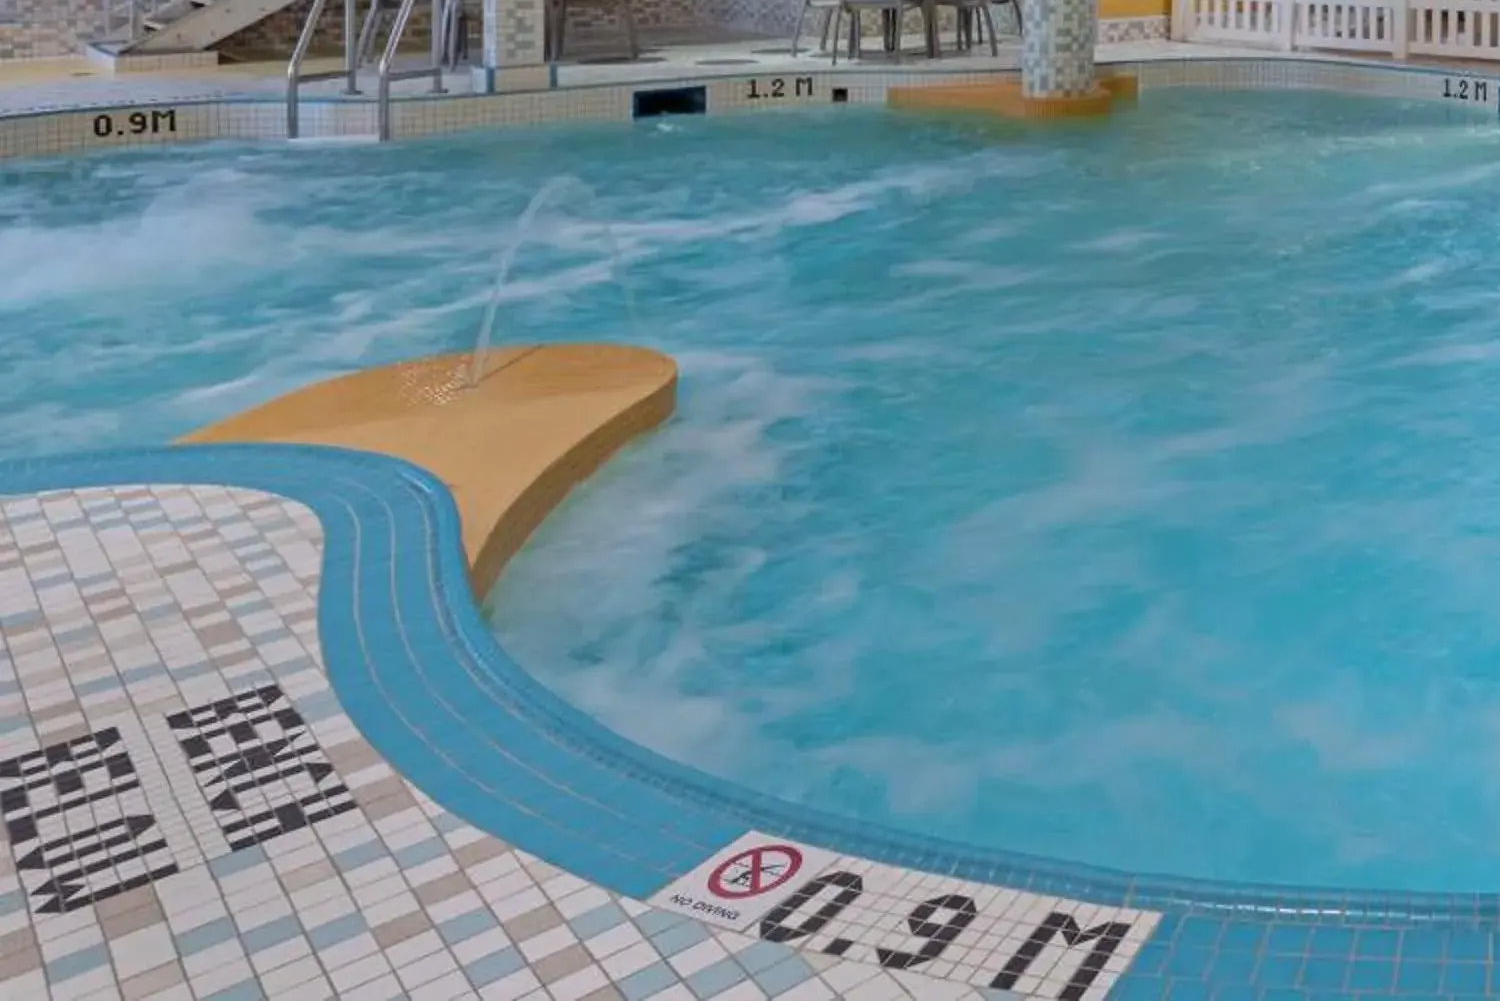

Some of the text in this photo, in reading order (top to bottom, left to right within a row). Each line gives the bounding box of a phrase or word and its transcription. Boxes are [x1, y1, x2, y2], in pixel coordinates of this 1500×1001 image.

[747, 77, 813, 99] 1.2 M
[1443, 78, 1487, 102] 1.2 M
[93, 109, 176, 137] 0.9M
[165, 684, 358, 851] BENCH
[0, 726, 180, 914] BELOW
[670, 894, 740, 920] NO DIVING
[760, 870, 1131, 1001] 0.9 M
